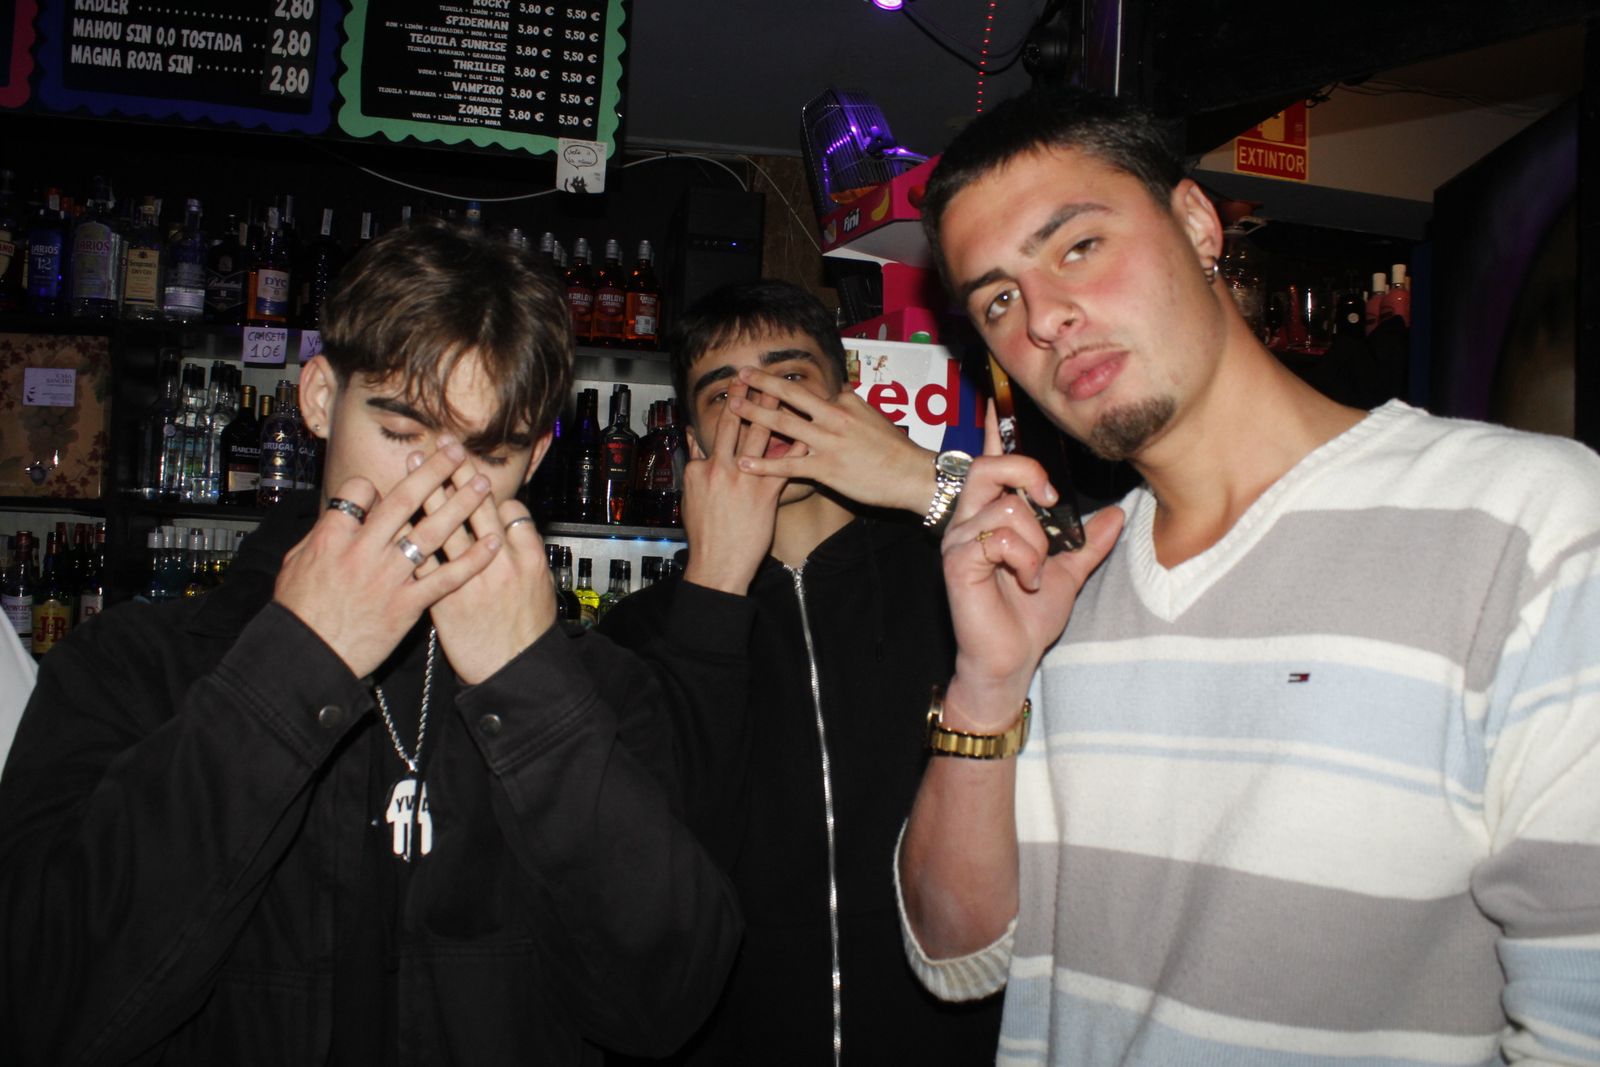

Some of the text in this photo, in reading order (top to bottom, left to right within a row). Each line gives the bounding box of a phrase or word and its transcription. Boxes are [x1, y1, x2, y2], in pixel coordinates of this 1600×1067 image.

[274, 0, 314, 21] 2,80
[445, 15, 509, 31] SPIDERMAN
[73, 17, 122, 40] MAHOU
[126, 24, 152, 44] SIN
[181, 28, 243, 53] TOSTADA
[271, 28, 311, 58] 2,80
[409, 33, 457, 47] TEQUILA
[461, 38, 508, 52] SUNRISE
[71, 44, 309, 94] MAGNA ROJA SIN 2,80
[453, 59, 505, 74] THRILLER
[451, 81, 504, 96] VAMPIRO
[458, 104, 502, 118] ZOMBIE
[1238, 146, 1305, 174] EXTINTOR
[231, 445, 261, 455] BARCEL
